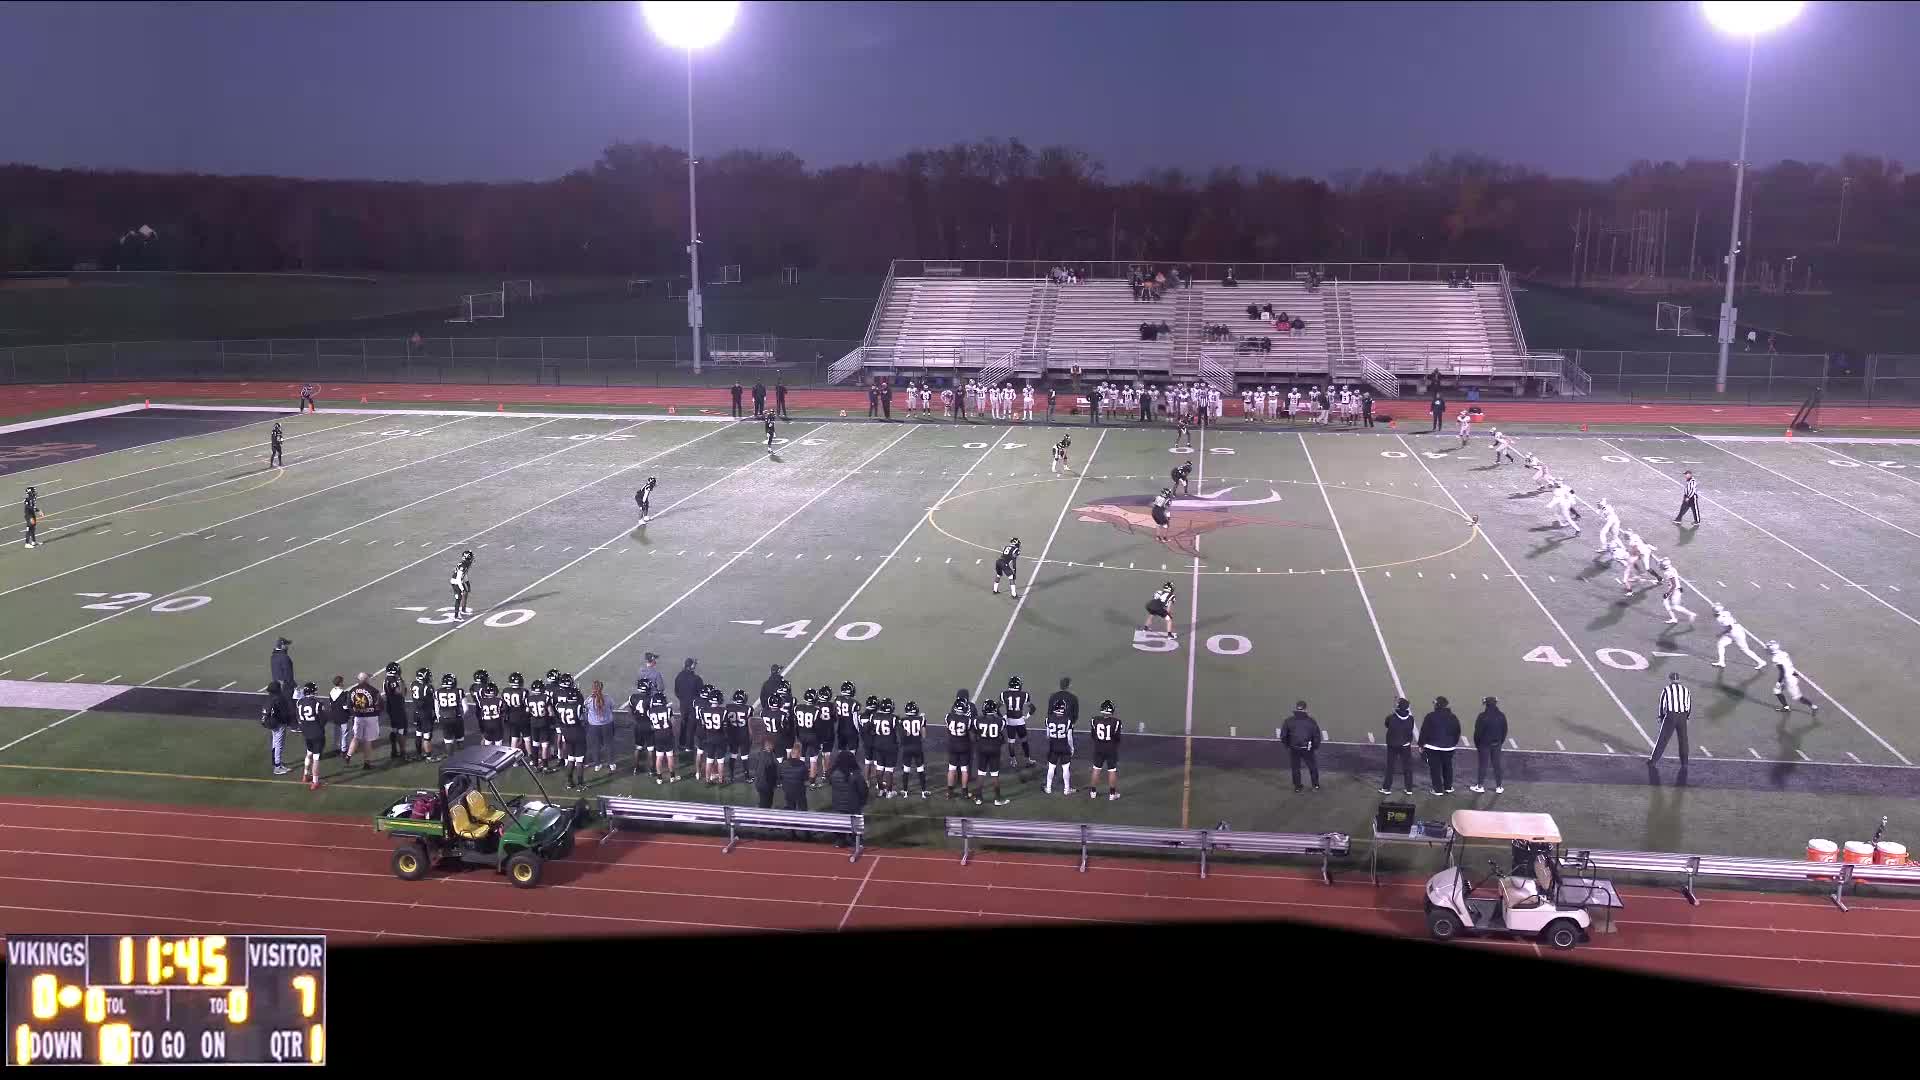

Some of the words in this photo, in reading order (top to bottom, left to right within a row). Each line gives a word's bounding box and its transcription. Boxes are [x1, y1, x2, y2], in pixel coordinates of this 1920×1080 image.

[1007, 696, 1021, 711] 11
[558, 708, 576, 725] 72
[650, 712, 669, 729] 27
[703, 712, 721, 730] 59
[762, 716, 779, 733] 51
[873, 719, 891, 735] 76
[948, 720, 966, 736] 42
[978, 723, 999, 738] 70
[1049, 722, 1066, 739] 22
[1096, 723, 1112, 740] 61
